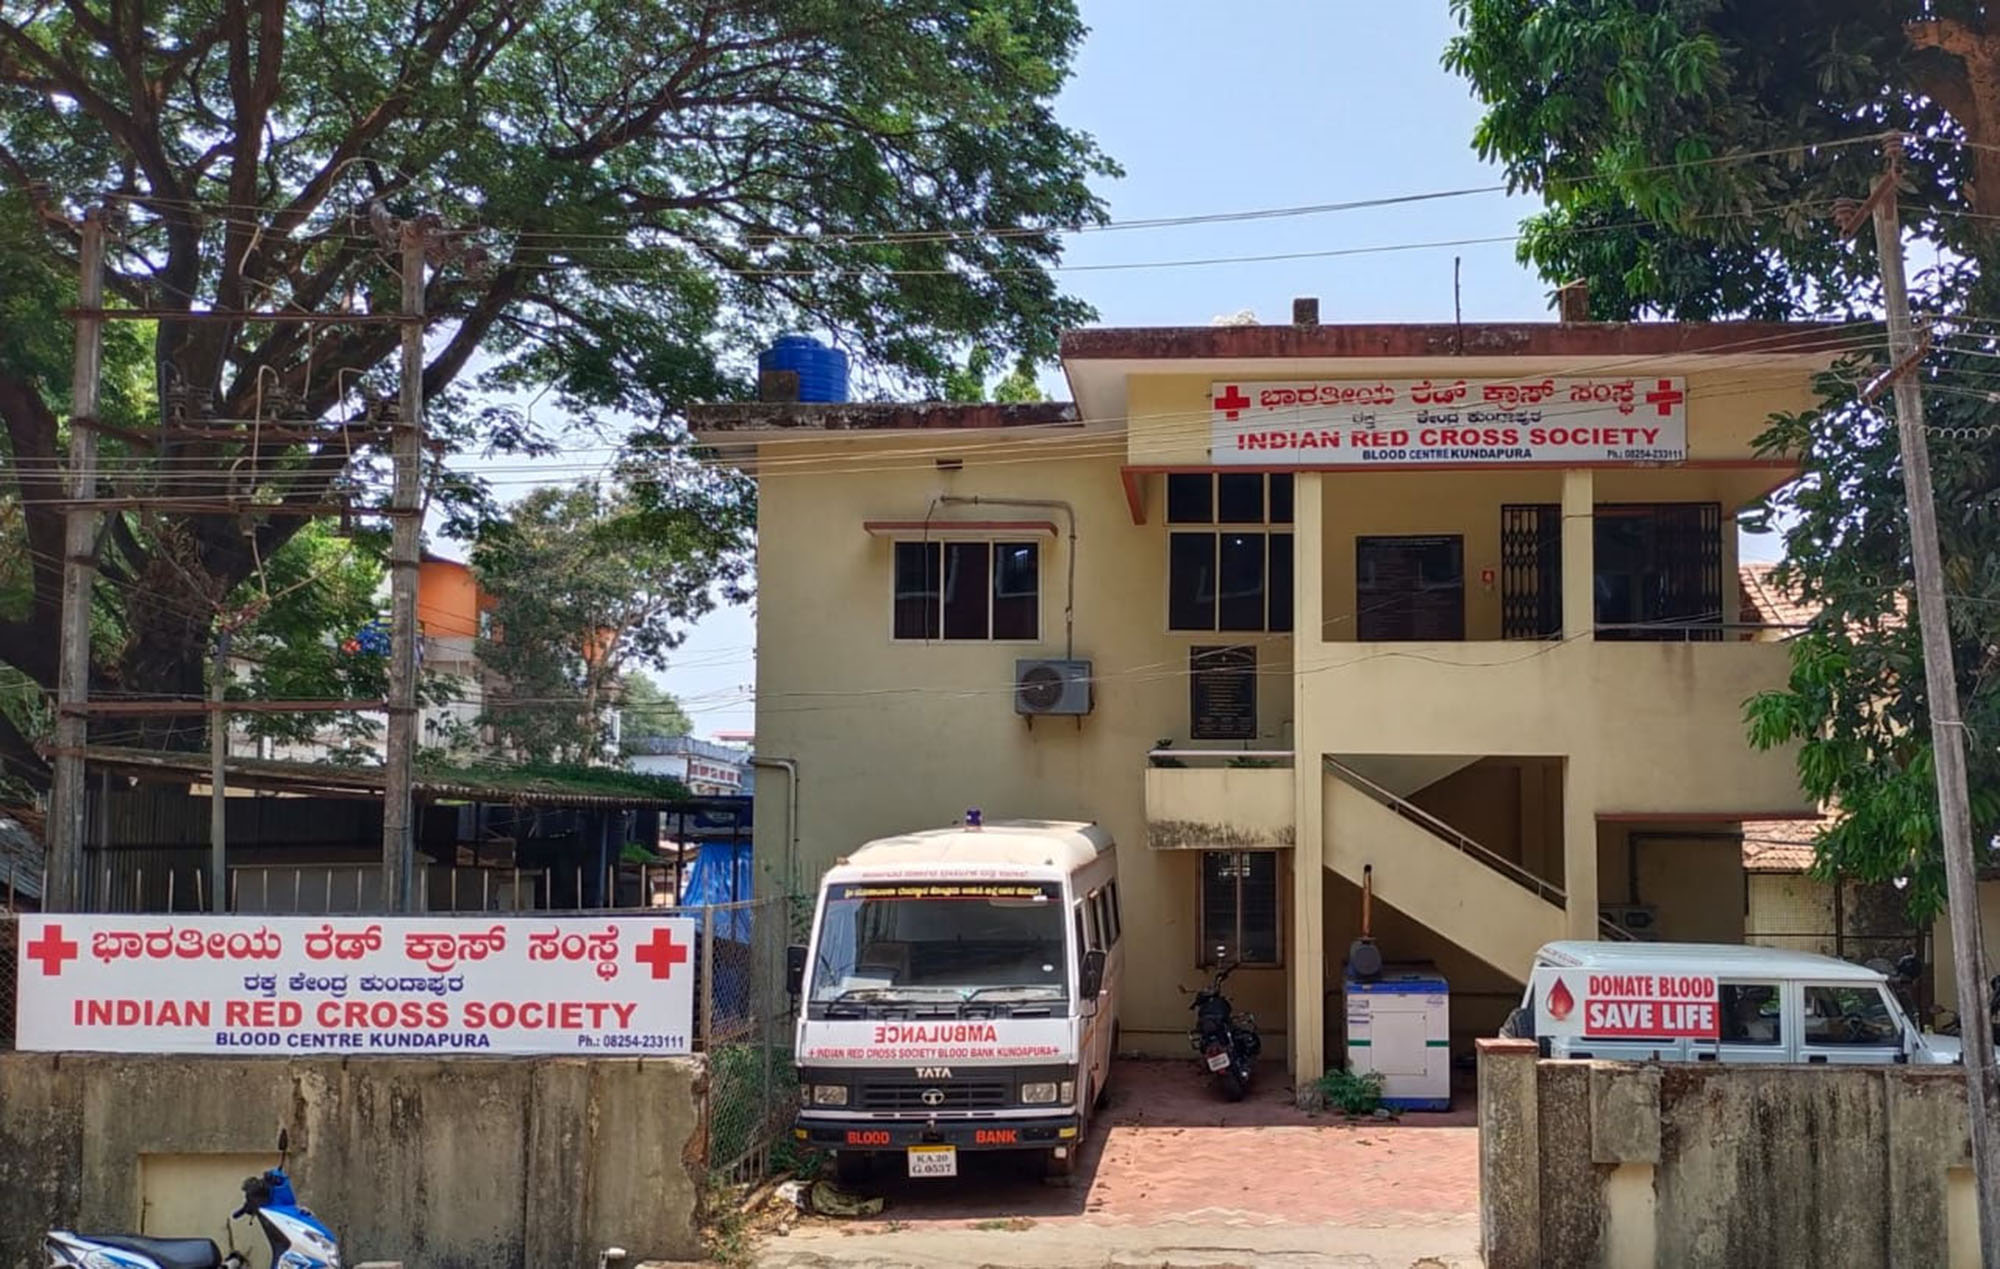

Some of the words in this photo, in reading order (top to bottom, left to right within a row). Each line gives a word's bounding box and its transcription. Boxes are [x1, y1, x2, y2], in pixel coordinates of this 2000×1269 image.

[1259, 382, 1395, 411] ಭಾರತೀಯ
[1411, 380, 1467, 405] ರೆಡ್
[1483, 379, 1554, 410] ಕ್ರಾಸ್
[1570, 379, 1635, 415] ಸಂಸ್ಥೆ
[1237, 430, 1341, 450] INDIAN
[1350, 429, 1409, 448] RED
[1419, 428, 1519, 447] CROSS
[1530, 427, 1660, 446] SOCIETY
[1362, 449, 1407, 461] BLOOD
[1409, 449, 1449, 460] CENTRE
[1450, 448, 1532, 460] KUNDAPURA
[1624, 449, 1683, 459] 08254-233111
[91, 926, 282, 963] ಭಾರತೀಯ
[305, 924, 382, 961] ರೆಡ್
[405, 925, 506, 973] ಕ್ರಾಸ್
[528, 924, 620, 981] ಸಂಸ್ಥೆ
[244, 974, 278, 997] ರಕ್ತ
[289, 972, 348, 998] ಕೇಂದ್ರ
[360, 972, 464, 997] ಕುಂದಾಪುರ
[1588, 975, 1653, 998] DONATE
[1658, 976, 1715, 998] BLOOD
[73, 999, 211, 1027] INDIAN
[225, 1000, 303, 1028] RED
[316, 1000, 449, 1030] CROSS
[462, 1001, 637, 1030] SOCIETY
[1588, 1002, 1654, 1029] SAVE
[1662, 1004, 1714, 1030] LIFE
[215, 1032, 281, 1046] BLOOD
[286, 1033, 363, 1048] CENTRE
[369, 1033, 490, 1048] KUNDAPURA
[577, 1034, 600, 1047] Ph.:
[603, 1034, 684, 1049] 08254-233111
[816, 1048, 845, 1059] INDIAN
[847, 1048, 865, 1059] RED
[867, 1048, 897, 1058] CROSS
[899, 1048, 936, 1058] SOCIETY
[938, 1047, 968, 1058] BLOOD
[970, 1047, 994, 1057] BANK
[997, 1046, 1052, 1057] KUNDAPURA
[915, 1068, 952, 1079] TATA
[847, 1131, 890, 1145] BLOOD
[975, 1130, 1017, 1143] BANK
